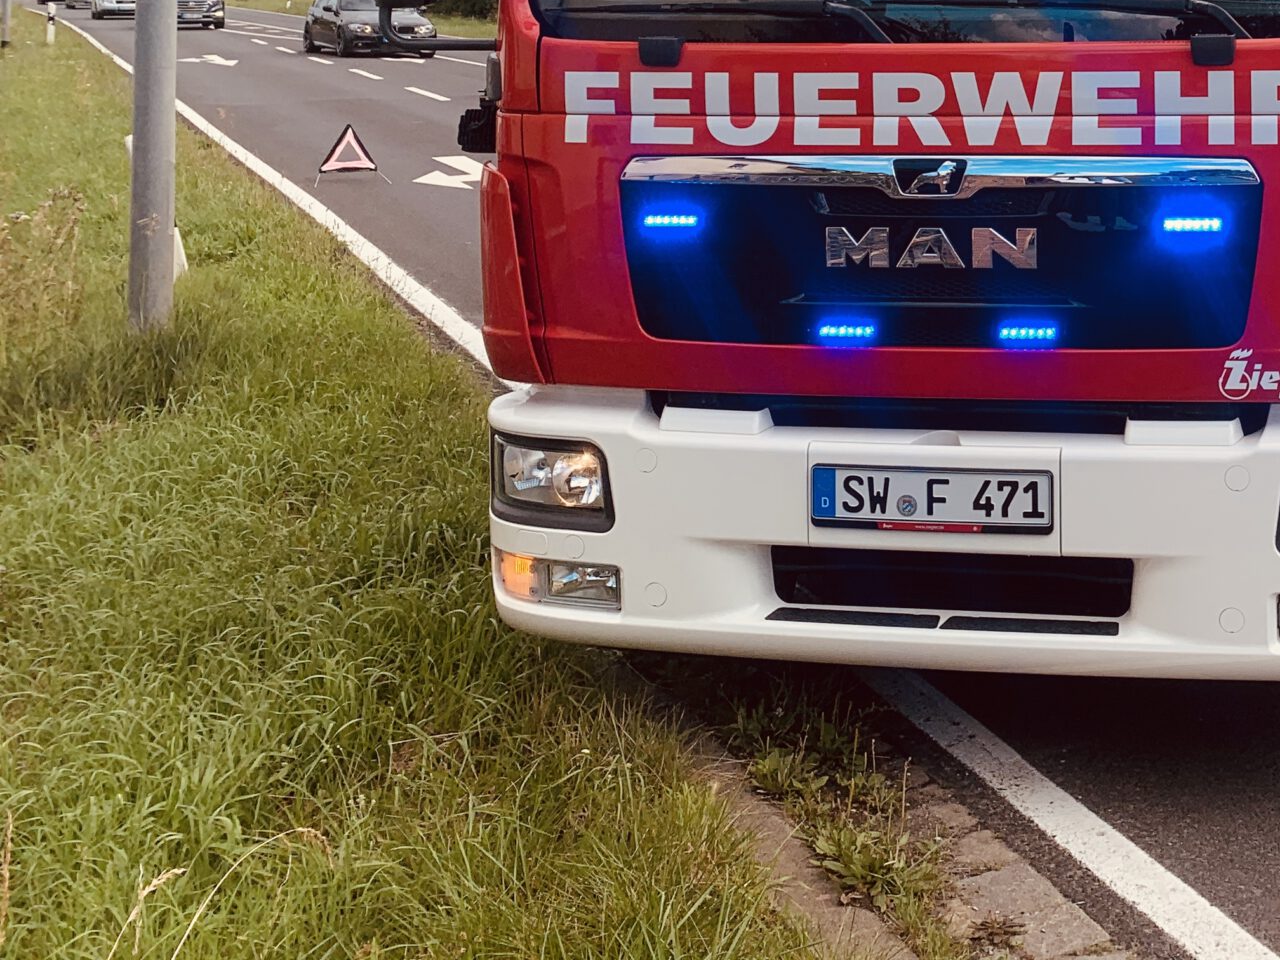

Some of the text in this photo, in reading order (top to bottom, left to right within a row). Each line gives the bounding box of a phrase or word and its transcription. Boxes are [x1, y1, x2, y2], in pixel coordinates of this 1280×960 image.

[825, 227, 1037, 269] MAN
[821, 497, 829, 507] D
[841, 475, 1045, 518] SW F 471
